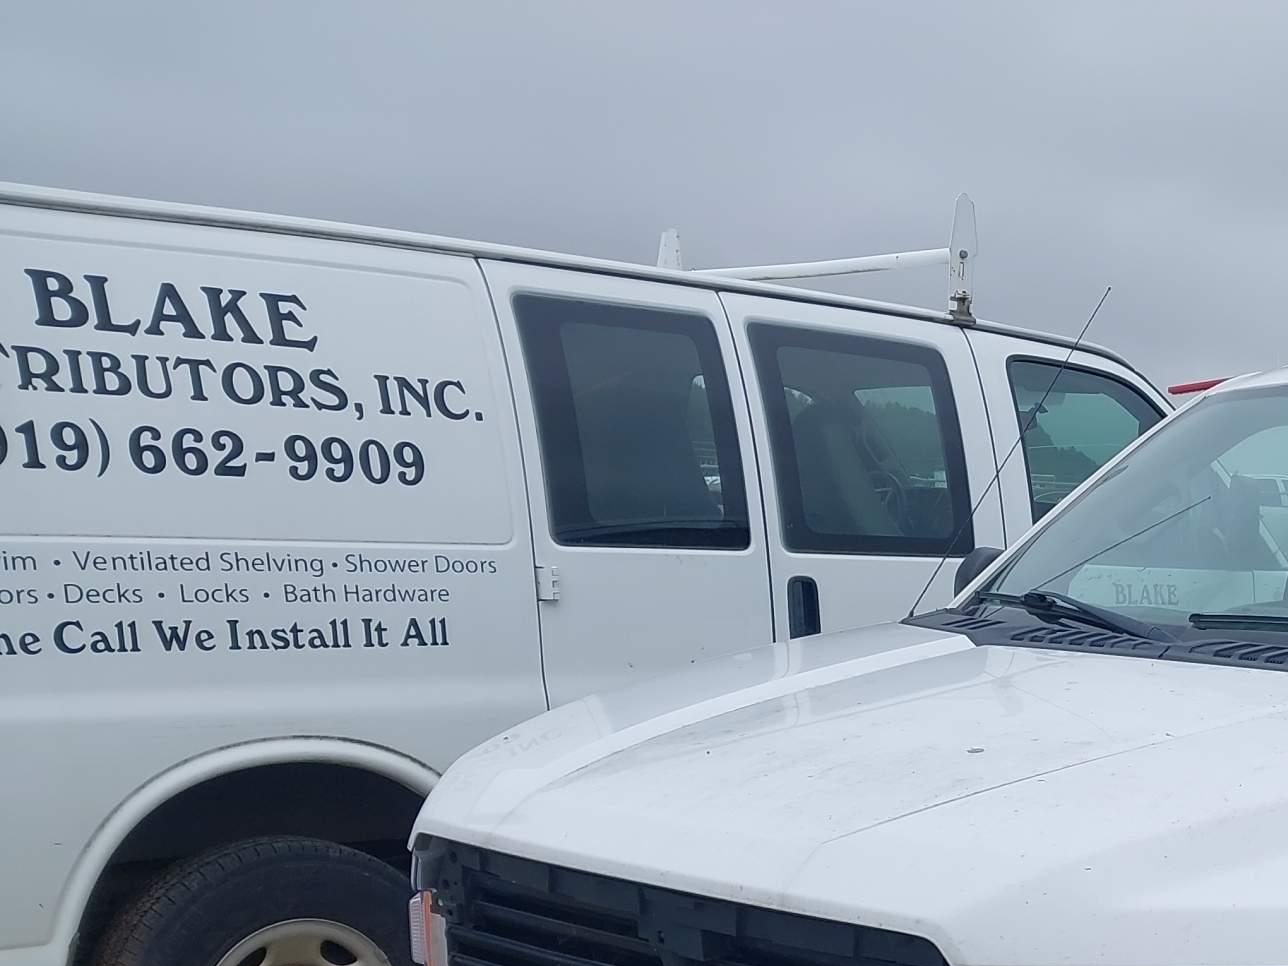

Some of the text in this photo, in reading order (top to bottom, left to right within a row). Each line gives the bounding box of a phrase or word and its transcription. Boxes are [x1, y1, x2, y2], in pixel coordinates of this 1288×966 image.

[23, 268, 319, 354] BLAKE
[0, 342, 484, 422] RIBUTORS, INC.
[0, 418, 426, 486] 19) 662-9909
[0, 550, 497, 578] im Ventilated Shelving Shower Doors
[63, 582, 143, 604] Decks
[179, 583, 250, 604] Locks
[283, 583, 337, 604] Bath
[343, 584, 450, 604] Hardware
[1112, 582, 1180, 606] BLAKE
[53, 619, 141, 655] Call
[151, 619, 217, 652] We
[225, 618, 353, 651] Install
[360, 618, 390, 649] It
[400, 617, 450, 648] All
